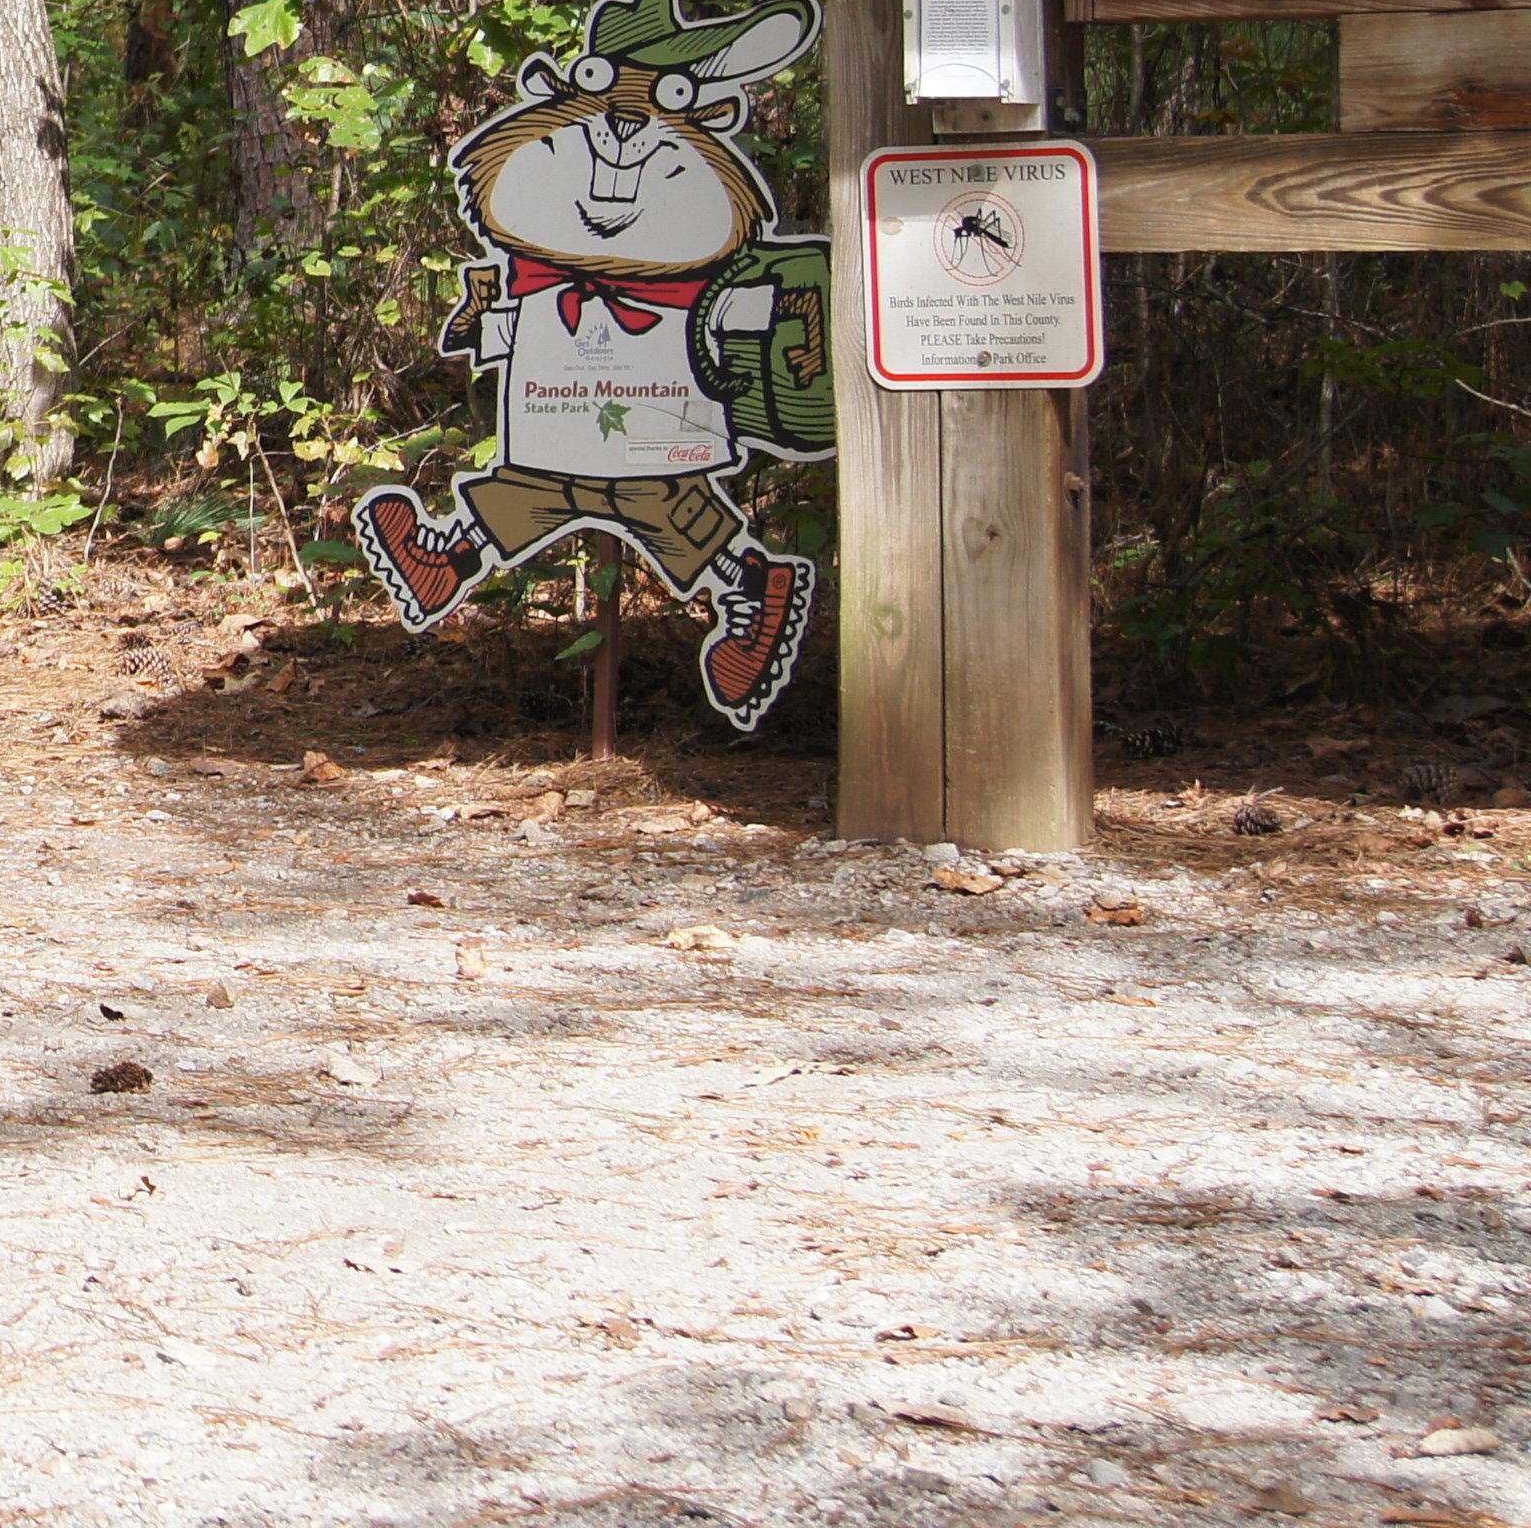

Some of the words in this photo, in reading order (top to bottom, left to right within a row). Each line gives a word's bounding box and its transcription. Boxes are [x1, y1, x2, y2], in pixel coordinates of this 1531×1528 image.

[890, 169, 944, 185] WEST
[1004, 164, 1065, 181] VIRUS
[889, 296, 914, 308] Birds
[916, 295, 953, 308] Infected
[956, 294, 979, 307] With
[982, 294, 999, 307] The
[1002, 293, 1024, 306] West
[1026, 293, 1046, 305] Nile
[1049, 292, 1075, 305] Virus
[906, 315, 930, 327] Have
[933, 315, 955, 327] Been
[958, 314, 987, 326] Found
[990, 314, 1000, 326] In
[1002, 313, 1022, 325] This
[920, 334, 962, 346] PLEASE
[965, 333, 986, 345] Take
[989, 332, 1045, 345] Precautions!
[578, 348, 613, 357] Outdoors
[921, 353, 977, 366] Information
[993, 353, 1014, 365] Park
[1016, 352, 1047, 365] Office
[524, 381, 588, 398] Panola
[594, 380, 689, 398] Mountain
[524, 402, 557, 414] State
[561, 401, 589, 414] Park
